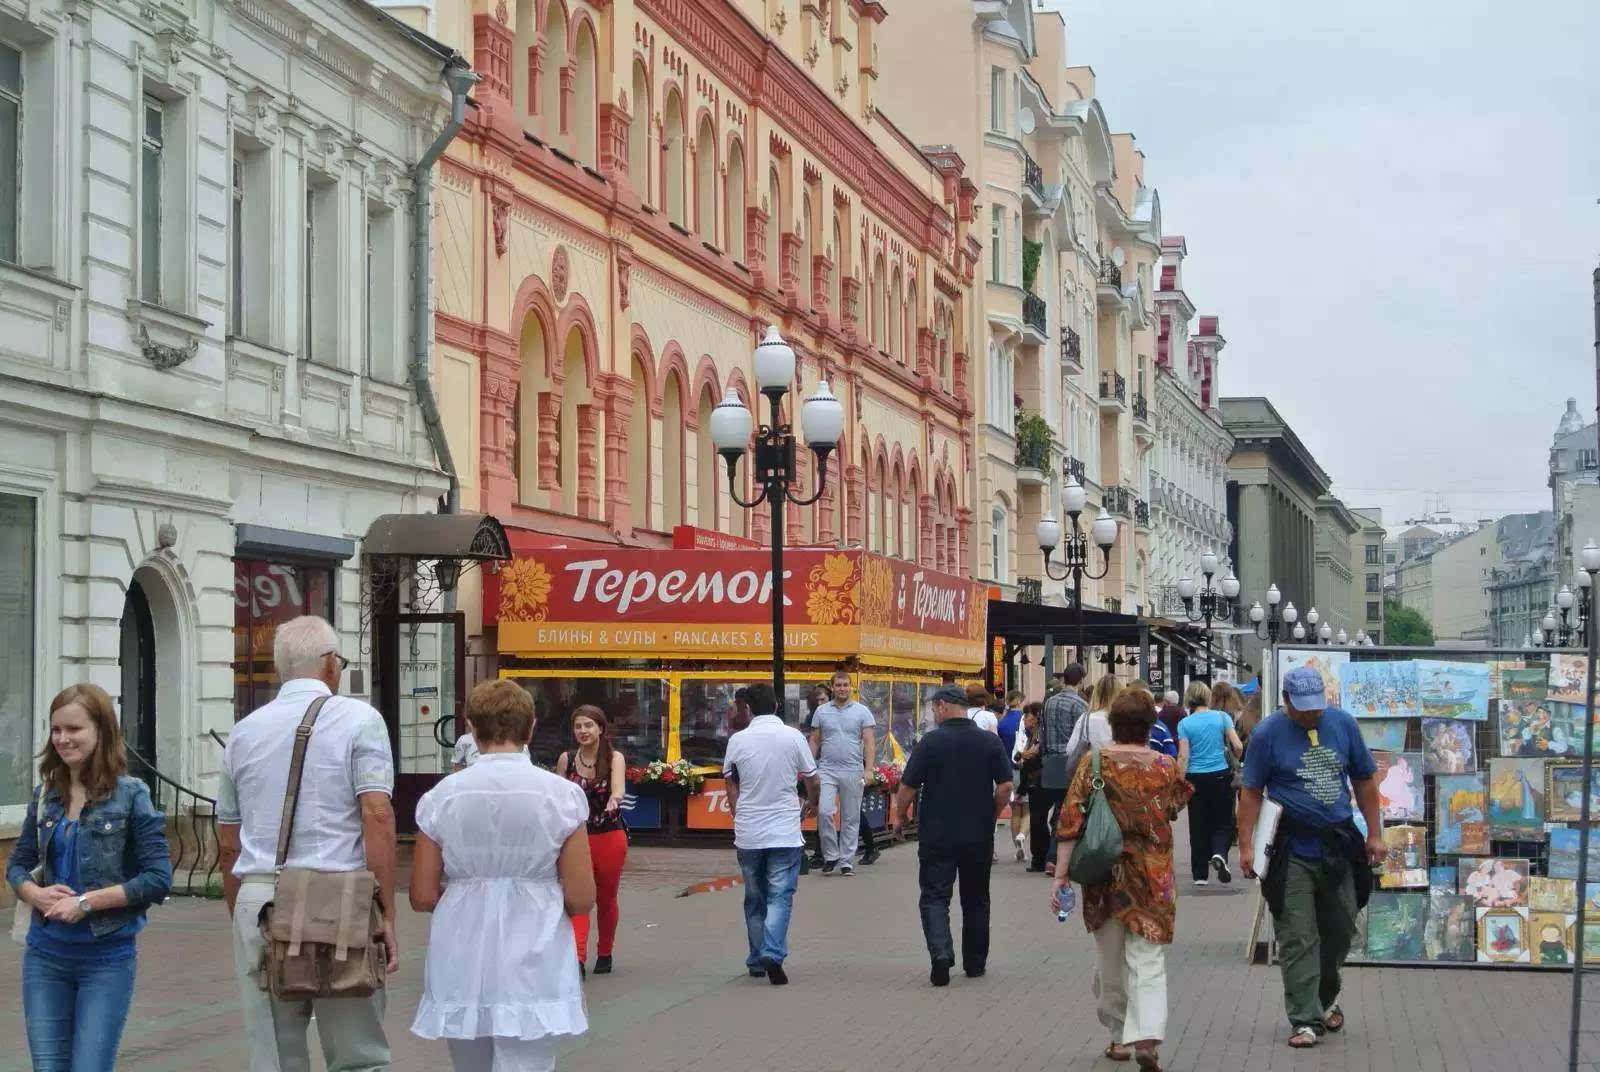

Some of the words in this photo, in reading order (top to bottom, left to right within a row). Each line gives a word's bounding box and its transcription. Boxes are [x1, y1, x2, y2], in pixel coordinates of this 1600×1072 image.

[565, 559, 793, 614] Теремок
[913, 571, 956, 629] Теремок
[538, 629, 593, 644] БЛИНЫ
[599, 630, 608, 644] &
[615, 631, 656, 645] СУПЫ
[673, 631, 748, 646] PANCAKES
[754, 631, 764, 646] &
